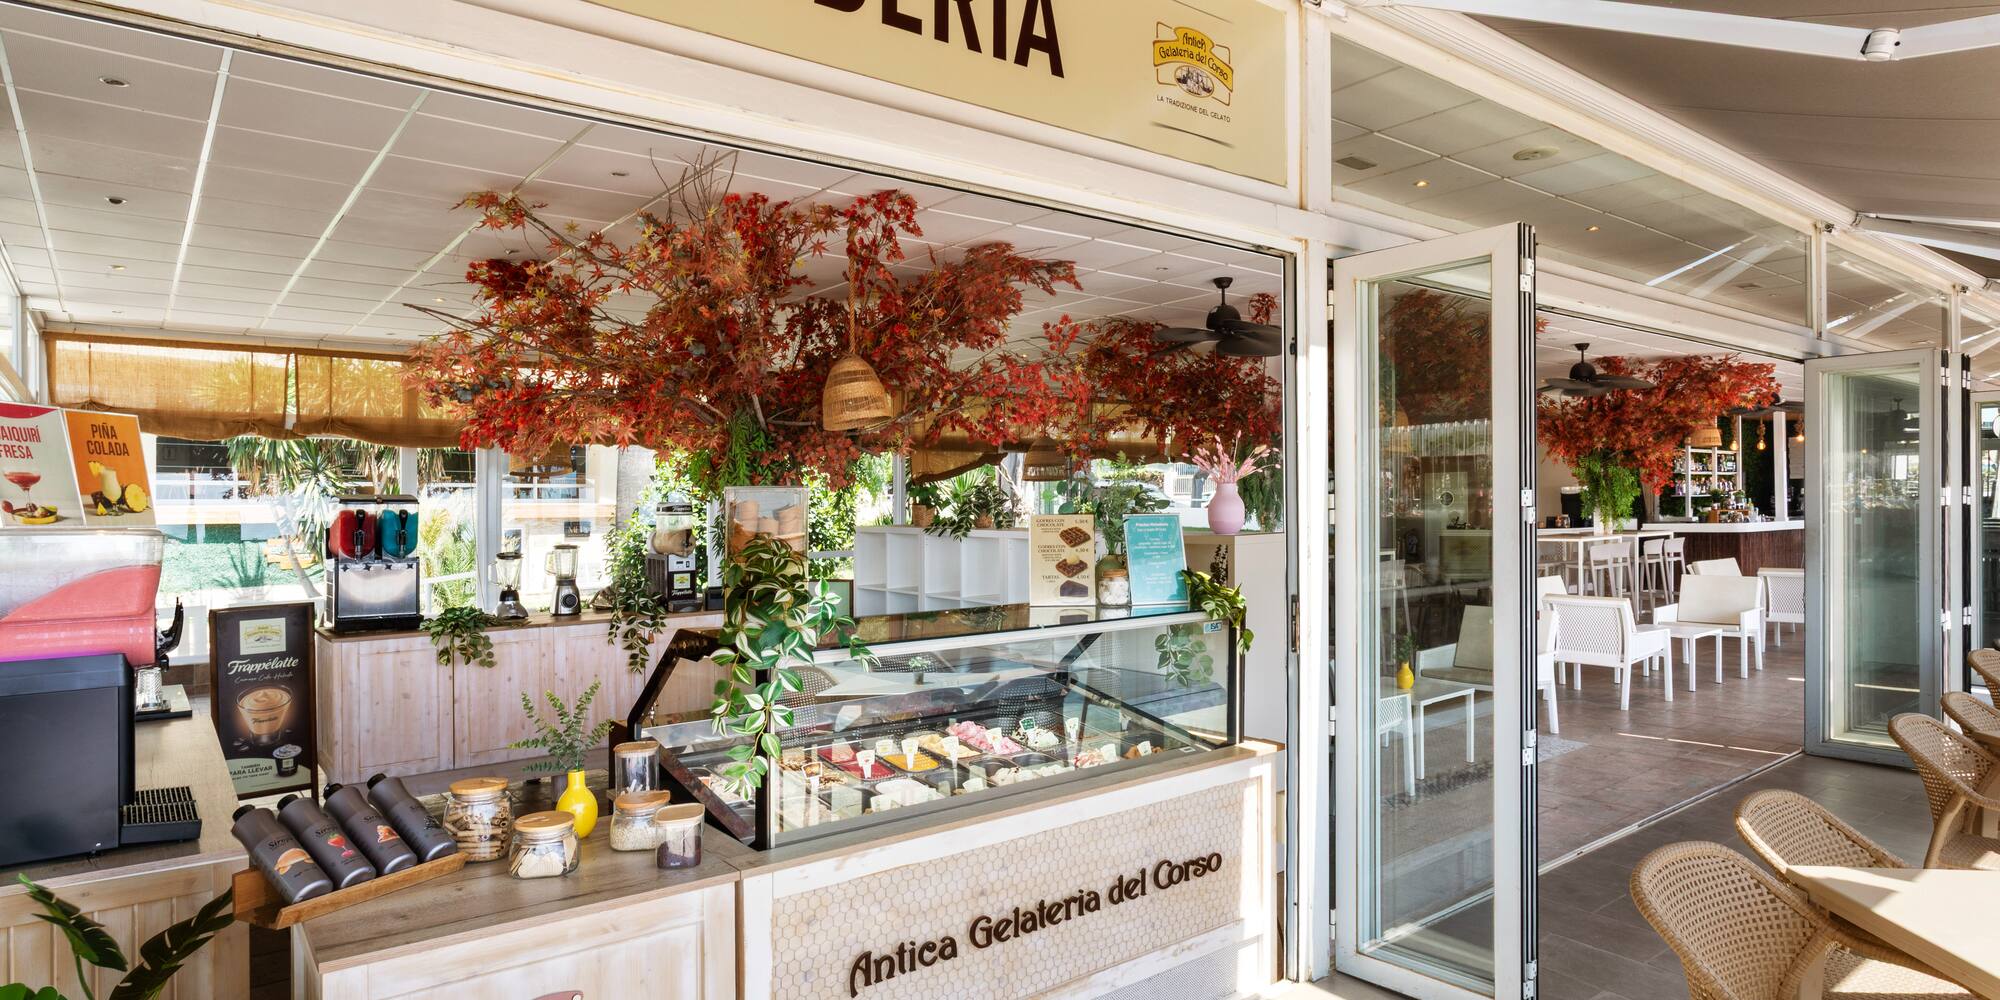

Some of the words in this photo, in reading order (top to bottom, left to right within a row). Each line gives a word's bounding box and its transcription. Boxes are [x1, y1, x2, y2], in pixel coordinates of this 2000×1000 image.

[814, 0, 1064, 78] RIA
[1158, 46, 1194, 60] Gelateria
[1207, 57, 1229, 81] Corso
[1166, 97, 1198, 113] TRADIZIONE
[1199, 107, 1209, 117] DEL
[1210, 111, 1231, 123] GELATO
[0, 425, 41, 443] AIQUIRÍ
[91, 422, 118, 440] PIÑA
[86, 440, 130, 457] COLADA
[227, 656, 299, 675] Frappélatte
[247, 765, 273, 774] LLEVAR
[849, 935, 958, 998] Antica
[968, 889, 1101, 949] Gelateria
[1107, 868, 1146, 905] del
[1153, 852, 1223, 890] Corso
